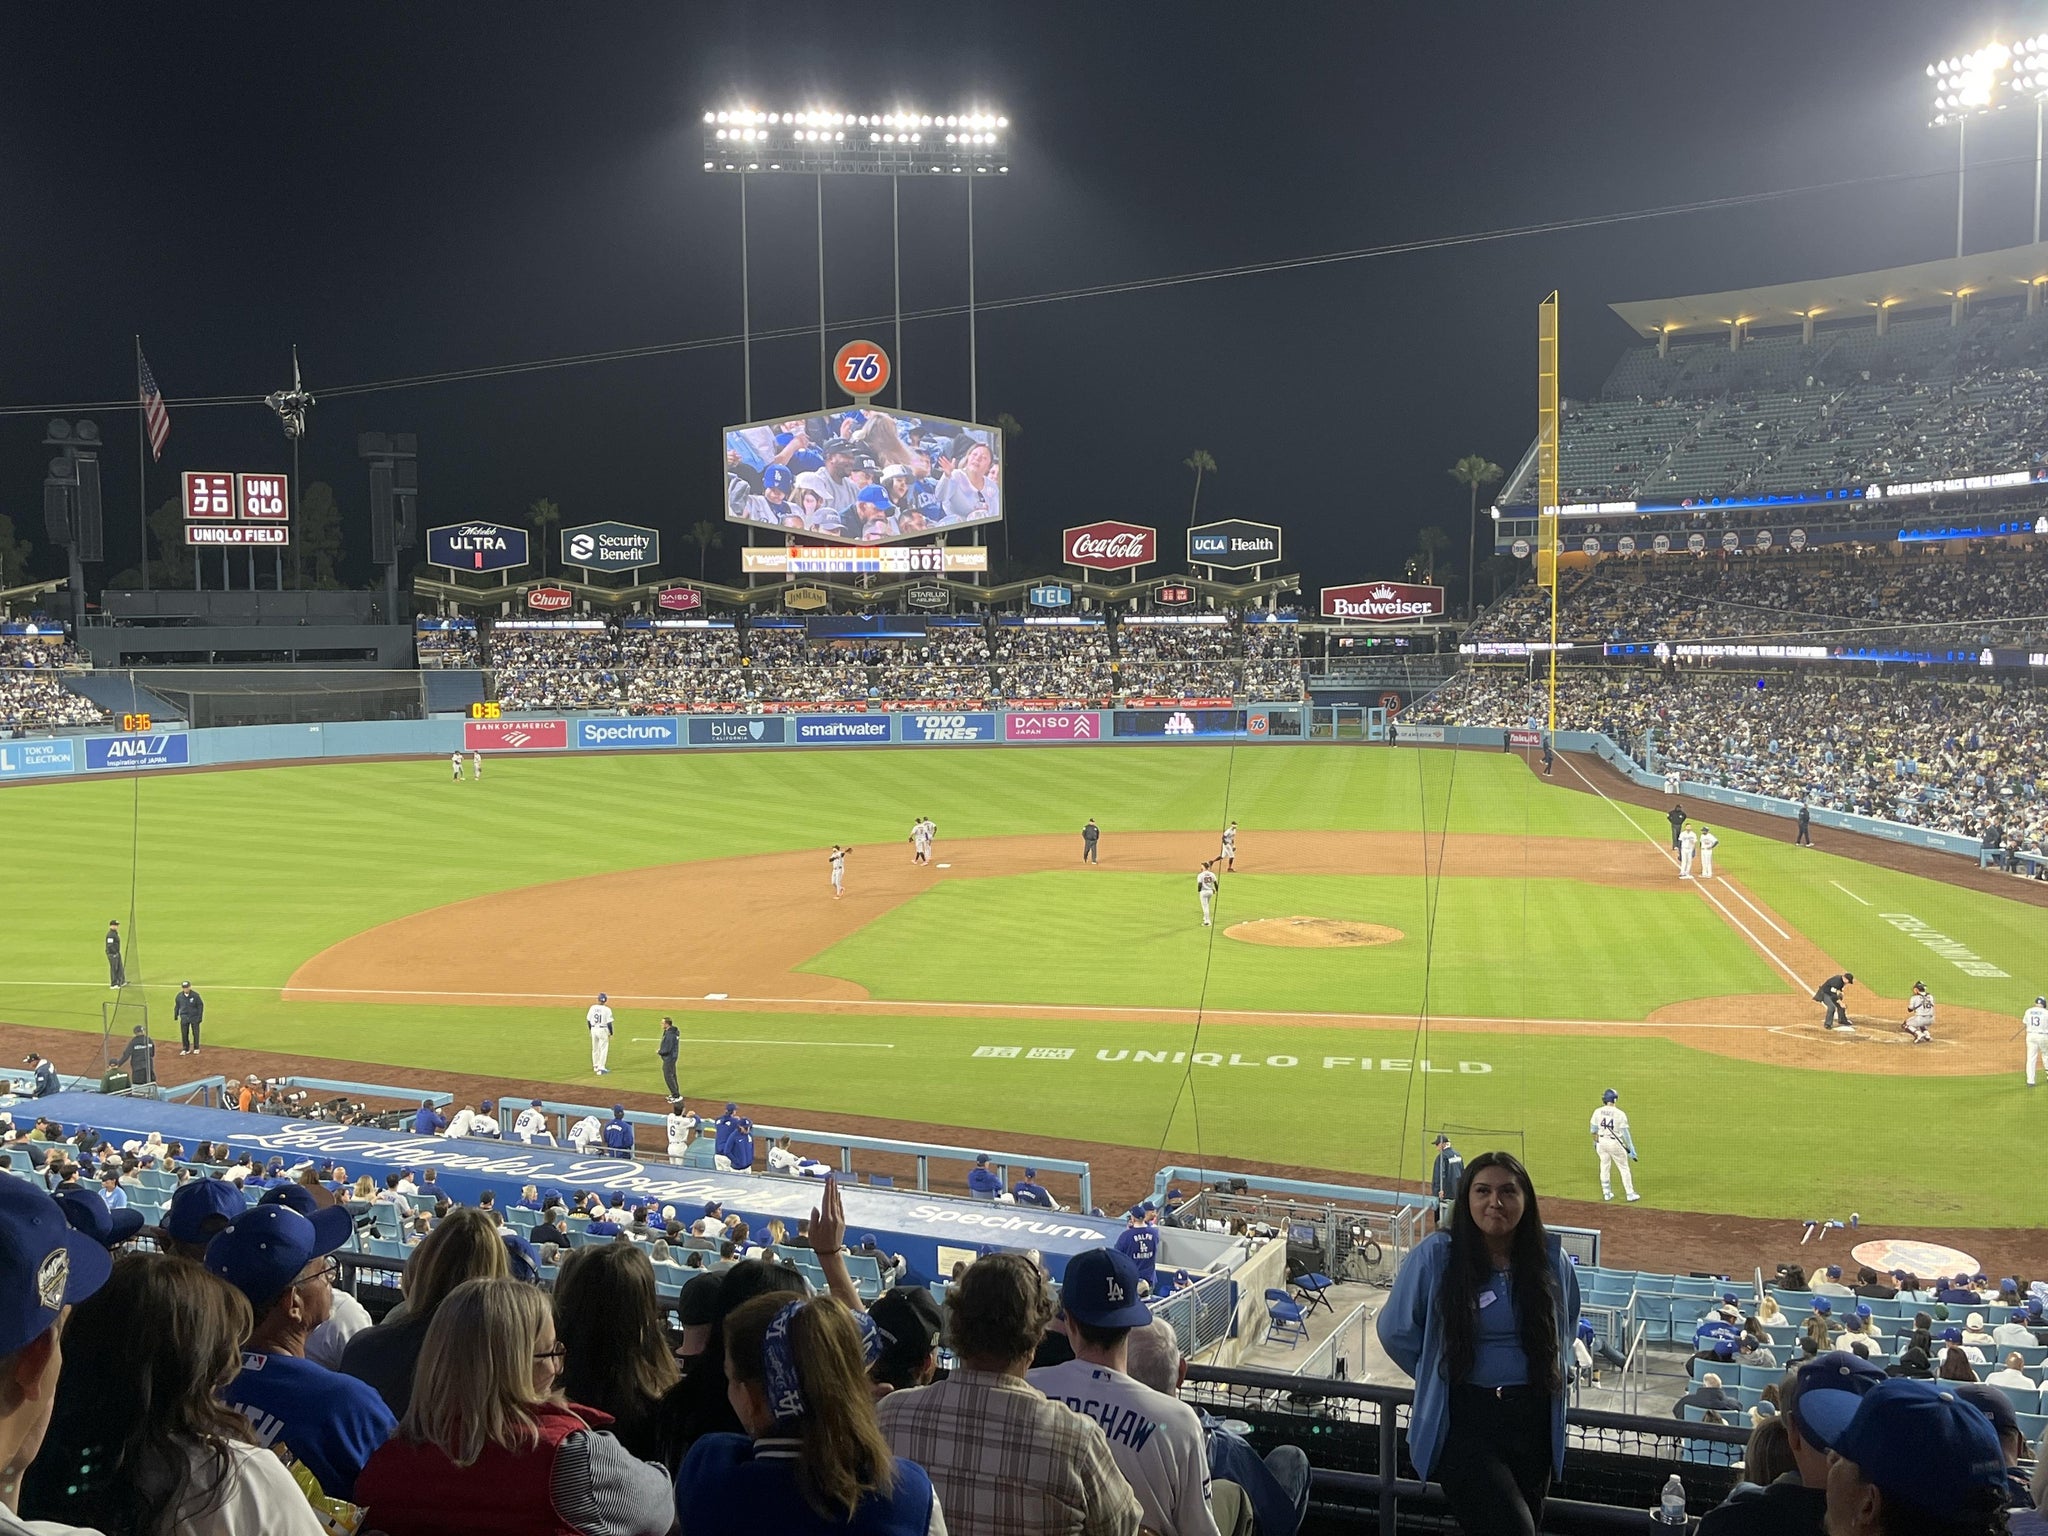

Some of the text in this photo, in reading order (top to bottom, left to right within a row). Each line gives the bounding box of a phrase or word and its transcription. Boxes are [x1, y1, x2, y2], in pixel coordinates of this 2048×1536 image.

[844, 353, 880, 382] 76
[247, 480, 279, 497] UNI
[247, 497, 282, 516] QLO
[193, 528, 283, 543] UNIQLO FIELD
[449, 536, 507, 550] ULTRA
[598, 533, 650, 549] Security
[1071, 532, 1147, 559] Coca-Cola
[1195, 537, 1274, 552] UCLA Health
[599, 547, 644, 560] Benefit
[530, 592, 570, 606] Churu
[788, 589, 823, 604] JIM BEAM
[1034, 589, 1067, 604] TEL
[1333, 597, 1430, 616] Budweiser
[472, 702, 501, 719] 0:36
[1382, 696, 1398, 711] 76
[123, 712, 152, 732] 0:36
[475, 723, 500, 731] BANK
[711, 721, 748, 736] blue
[914, 715, 967, 728] TOYO
[1015, 716, 1070, 728] DAISO
[1251, 718, 1265, 731] 76
[584, 723, 667, 743] Spectrum
[801, 722, 886, 737] smartwater
[923, 727, 979, 740] TIRES
[24, 745, 54, 756] TOKYO
[107, 739, 147, 758] ANA
[25, 753, 71, 765] ELECTRON
[2031, 1016, 2041, 1027] 13
[1095, 1049, 1492, 1074] UNIQLO FIELD
[1600, 1117, 1614, 1130] 44
[227, 1123, 801, 1208] Los Angeles Dodgers
[908, 1204, 1094, 1241] Spectrum
[1106, 1276, 1124, 1302] LA
